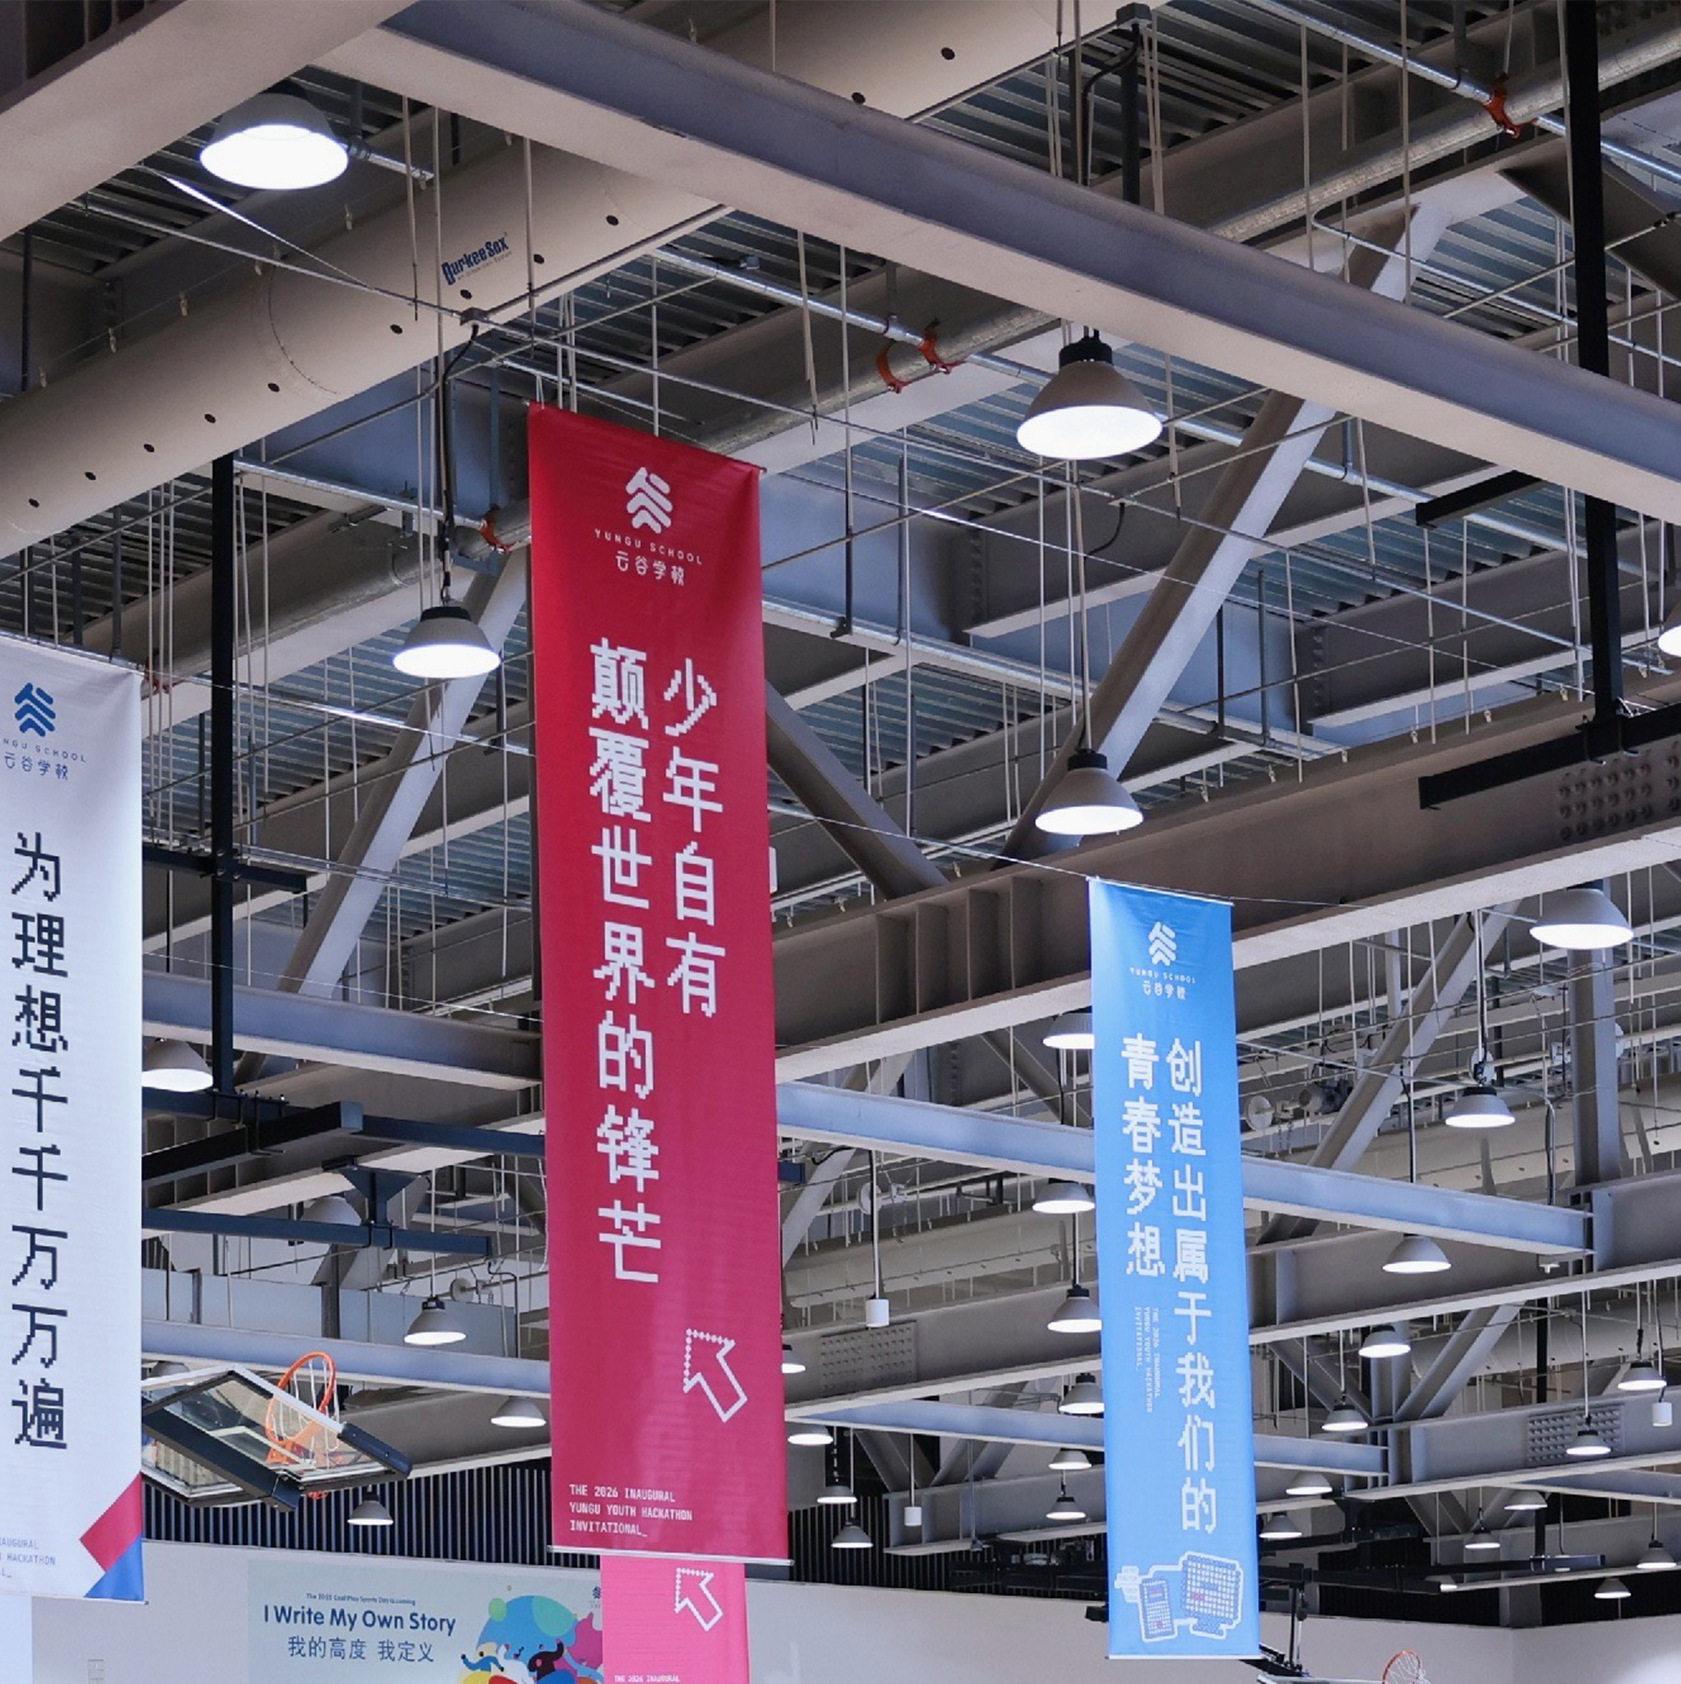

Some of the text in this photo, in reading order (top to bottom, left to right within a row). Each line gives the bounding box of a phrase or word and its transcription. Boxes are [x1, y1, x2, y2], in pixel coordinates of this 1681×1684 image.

[441, 236, 509, 285] DurkeeSox
[594, 529, 703, 565] YUNGU SCHOOL
[615, 551, 684, 586] 云谷学校
[4, 751, 69, 780] 云谷学校
[36, 745, 86, 764] SCHOOL
[663, 658, 726, 1017] 少年自有
[589, 637, 662, 1283] 颠覆世界的锋芒
[11, 831, 69, 1450] 为理想千千万万遍
[1121, 1032, 1166, 1277] 青春梦想
[1166, 1037, 1217, 1534] 创造出属于我们的
[569, 1484, 675, 1502] THE 2026 INAUGURAL
[570, 1502, 693, 1521] YUNGU YOUTH HACKATHON
[6, 1552, 56, 1566] HACKATHON
[264, 1605, 456, 1636] I Write My Own Story
[288, 1636, 434, 1663] 我的高度 我定义
